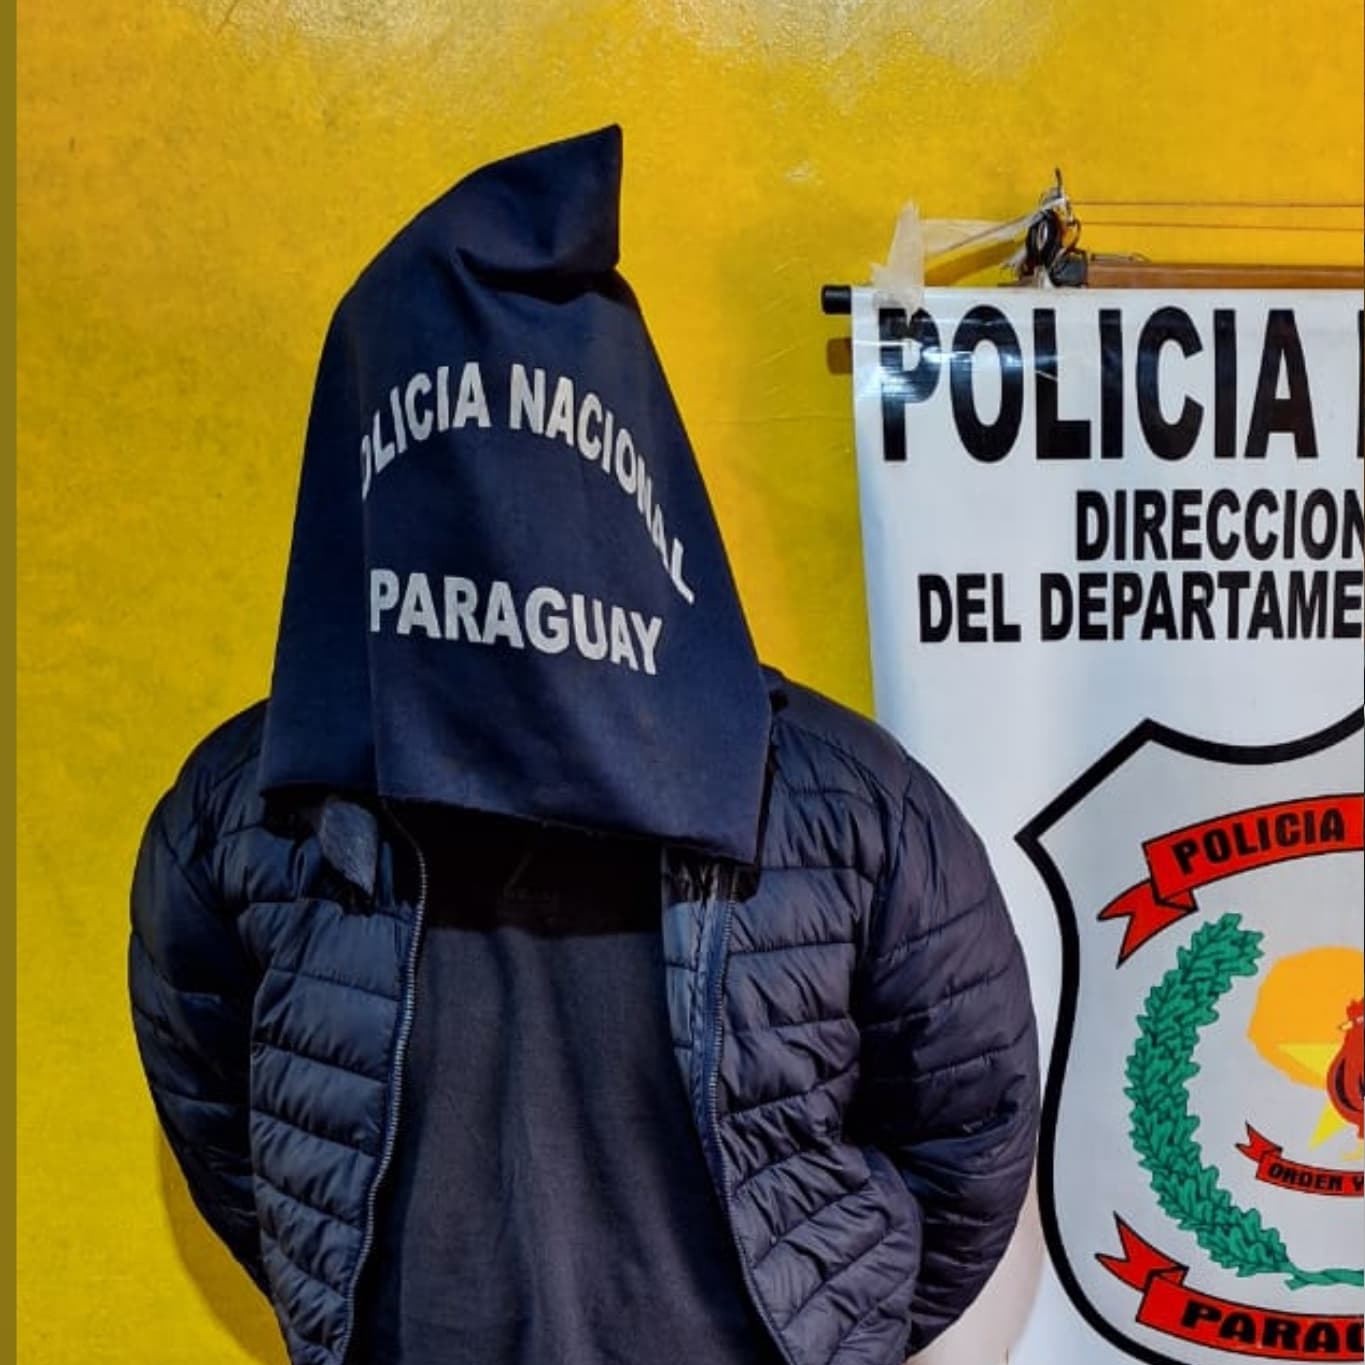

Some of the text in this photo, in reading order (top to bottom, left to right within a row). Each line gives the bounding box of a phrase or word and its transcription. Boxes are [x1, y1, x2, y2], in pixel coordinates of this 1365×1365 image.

[877, 304, 1319, 463] POLICIA
[509, 363, 695, 604] NACIONAL
[369, 568, 663, 675] PARAGUAY
[917, 570, 1364, 643] DEL DEPARTAME
[1172, 807, 1345, 876] POLICIA
